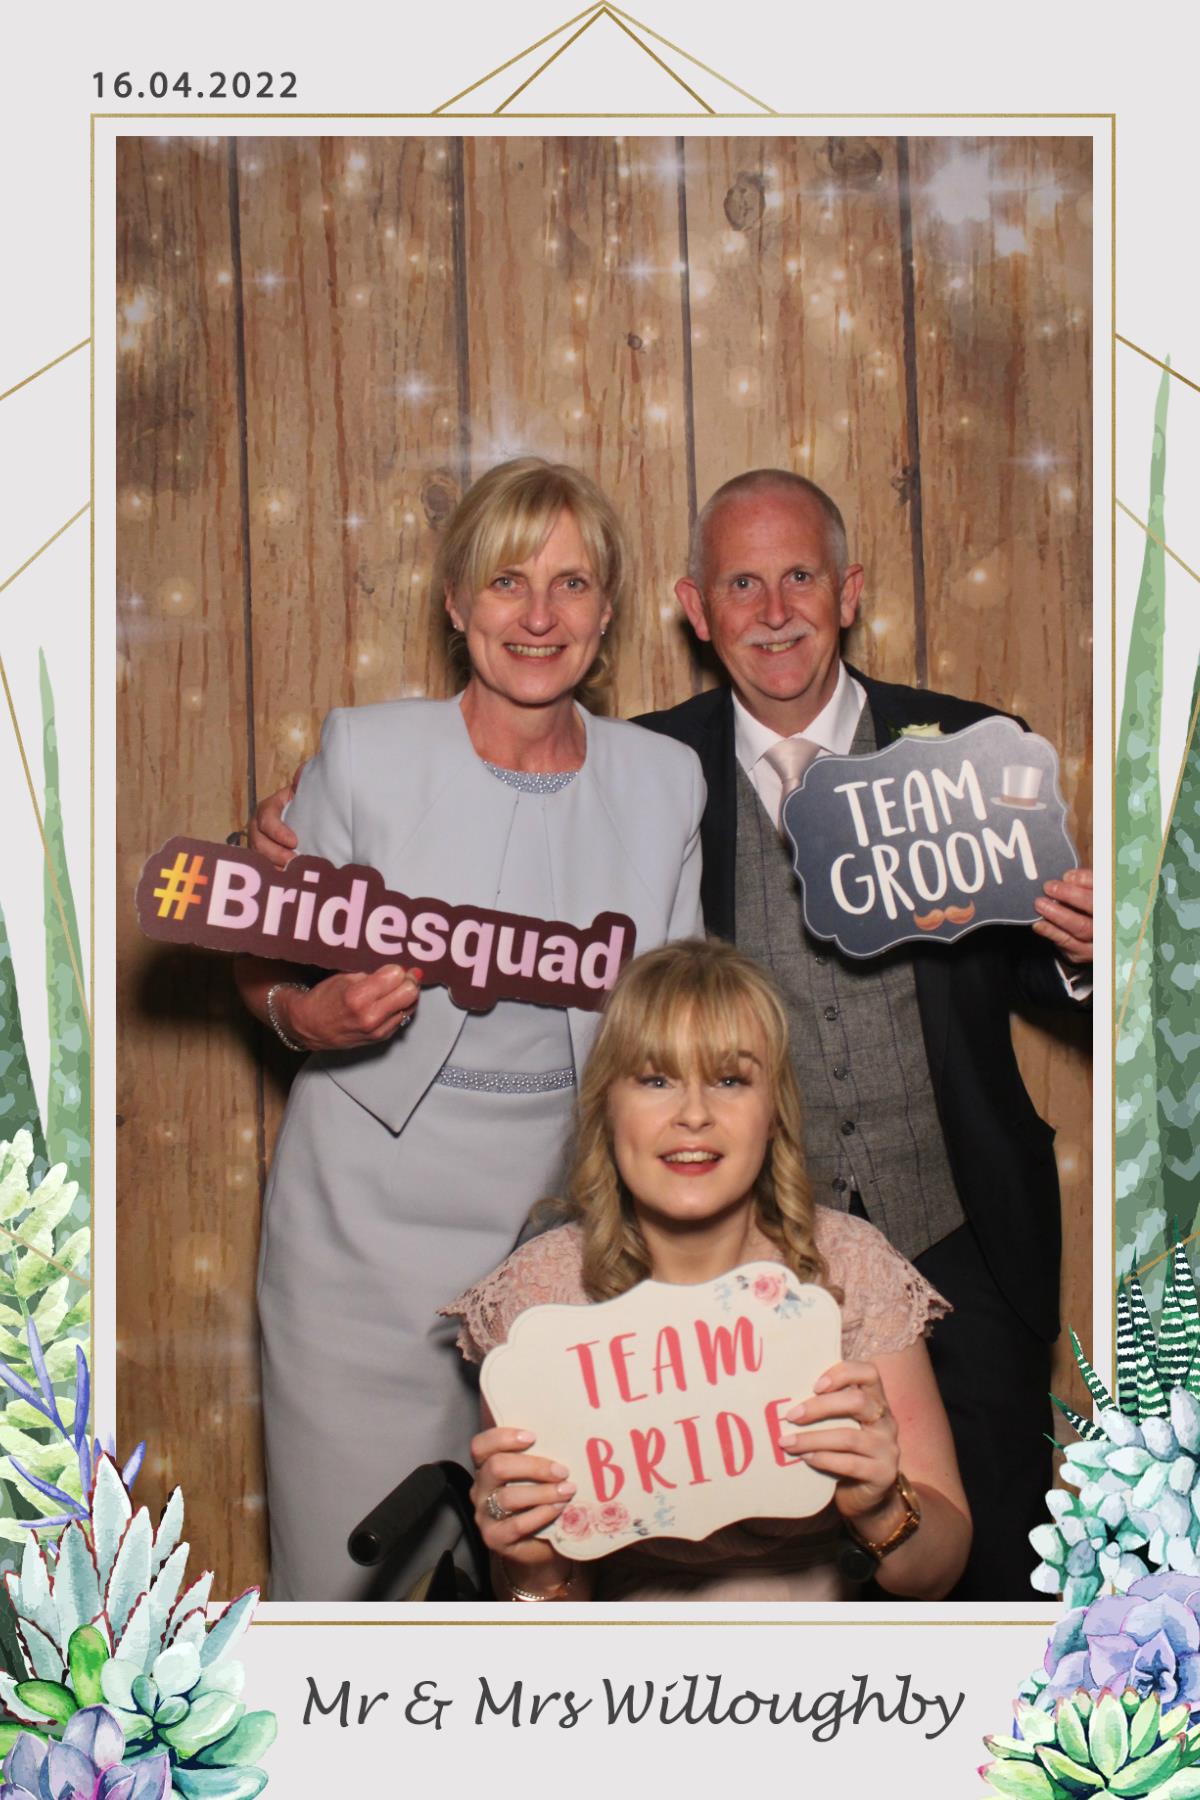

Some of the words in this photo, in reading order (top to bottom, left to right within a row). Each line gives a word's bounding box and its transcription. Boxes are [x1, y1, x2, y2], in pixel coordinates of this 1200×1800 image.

[833, 759, 988, 848] TEAM
[152, 851, 626, 990] #Bridesquad
[830, 818, 1039, 921] GROOM
[564, 1315, 764, 1410] TEAM
[584, 1397, 804, 1504] BRIDE
